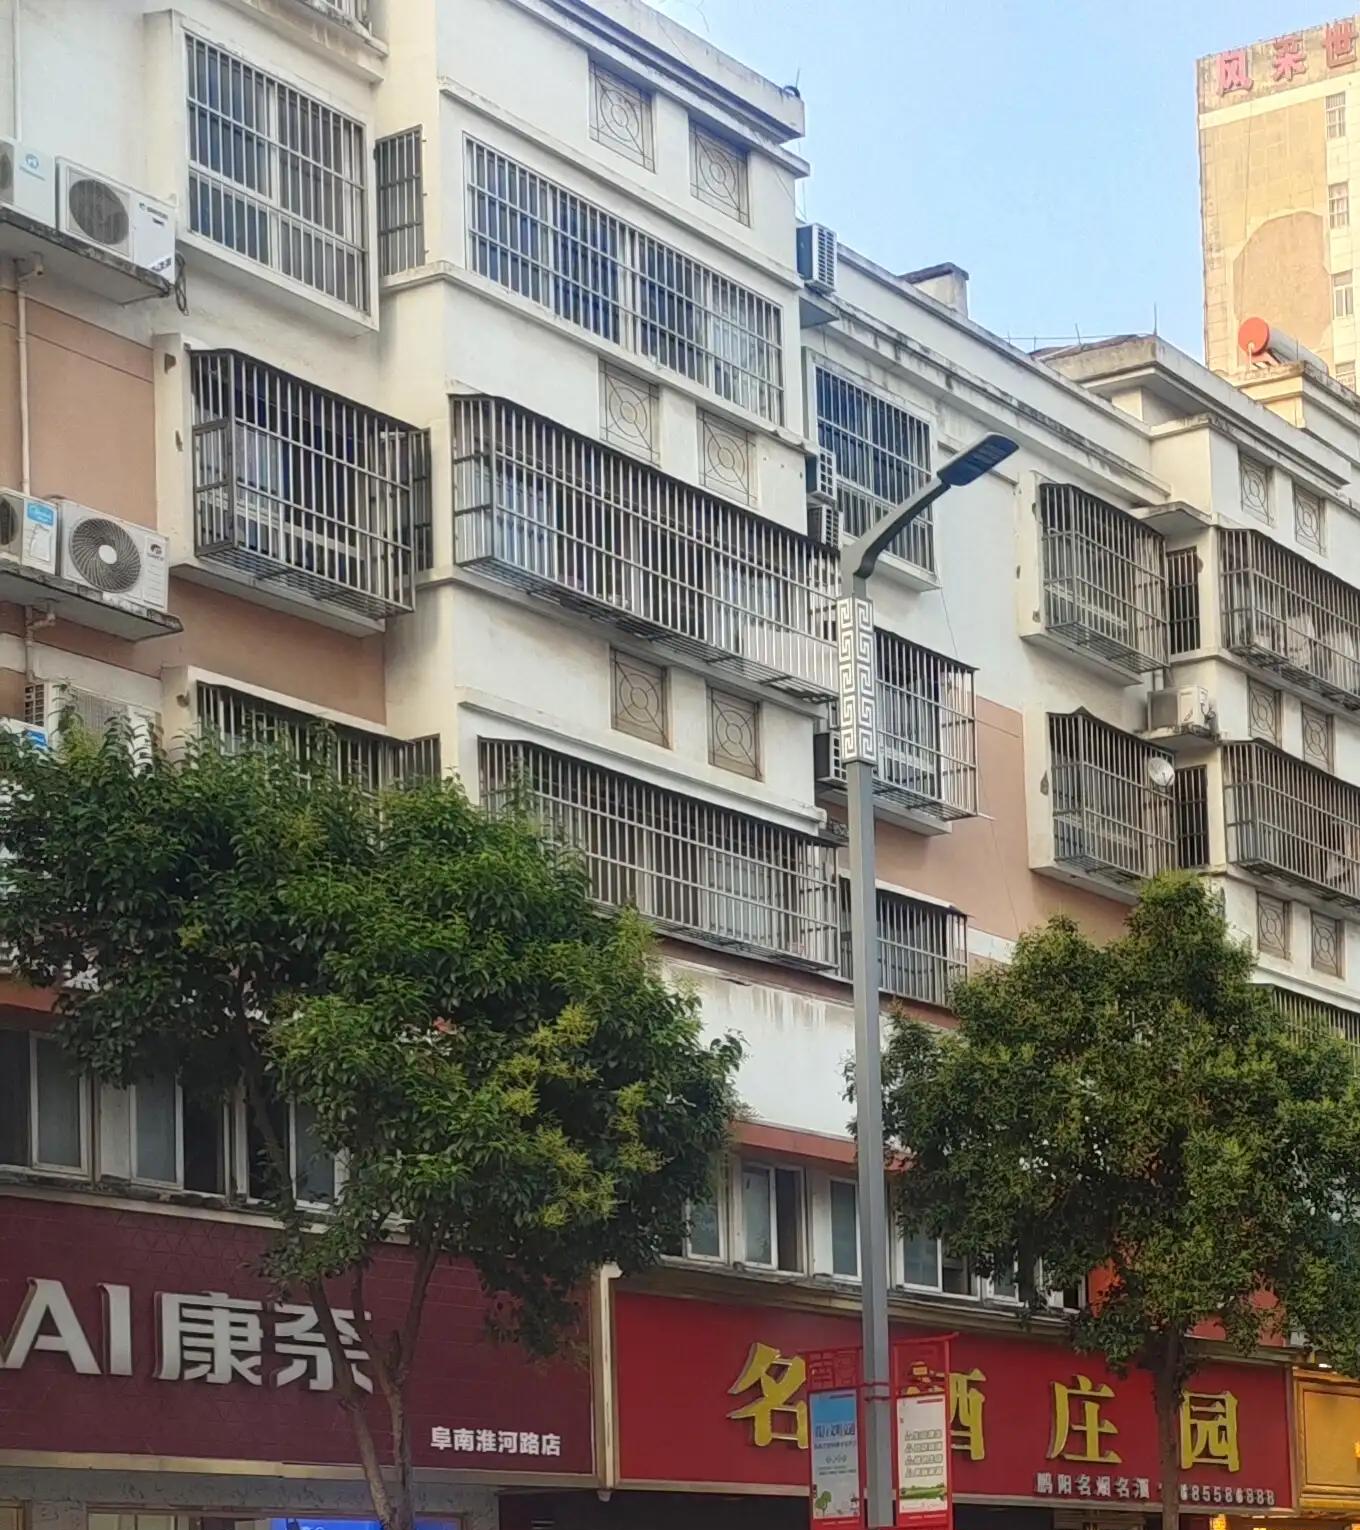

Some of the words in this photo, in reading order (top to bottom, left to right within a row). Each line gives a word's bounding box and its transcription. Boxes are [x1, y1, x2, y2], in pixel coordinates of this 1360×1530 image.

[153, 1291, 374, 1395] 康奈
[431, 1425, 562, 1458] 阜南淮河路店
[1036, 1472, 1150, 1499] 鹏阳名烟名酒
